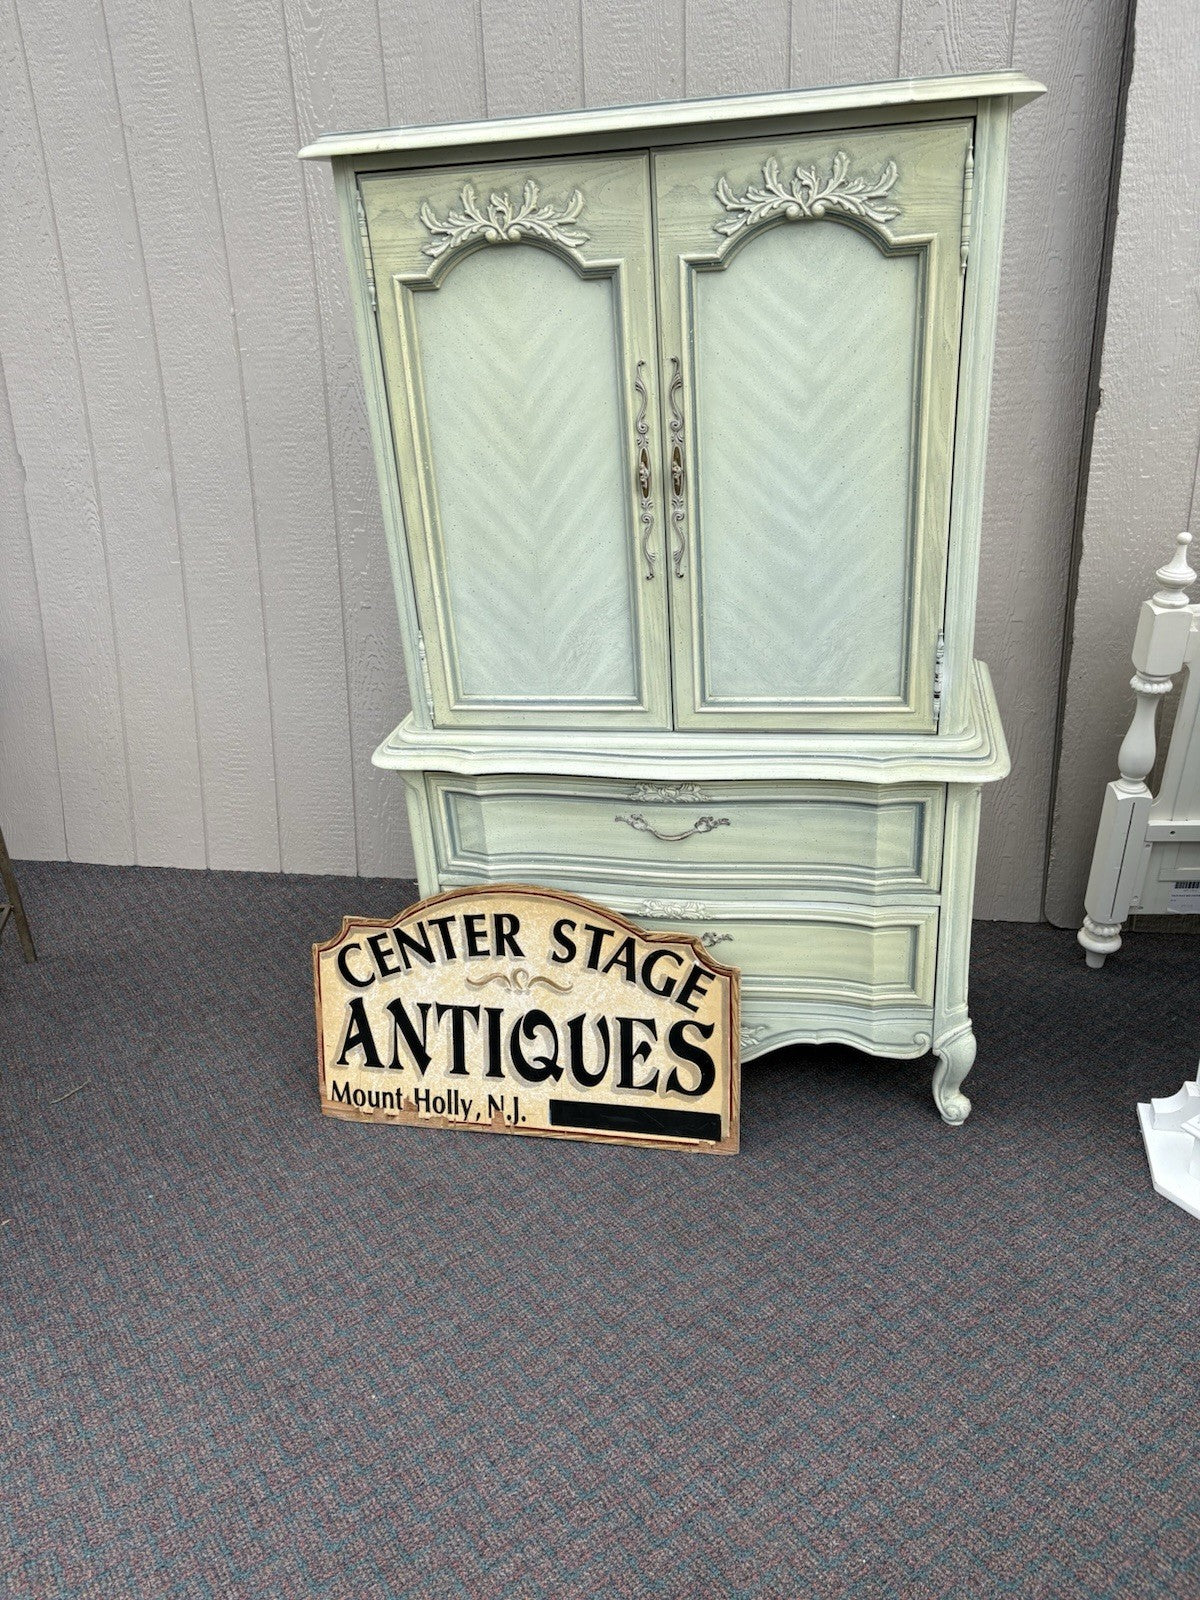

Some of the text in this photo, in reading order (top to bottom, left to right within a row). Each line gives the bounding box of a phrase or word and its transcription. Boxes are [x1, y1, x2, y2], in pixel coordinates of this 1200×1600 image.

[337, 913, 716, 1013] CENTER STAGE
[336, 996, 717, 1097] ANTIQUES
[332, 1080, 403, 1111] Mount
[488, 1094, 526, 1125] N.J.
